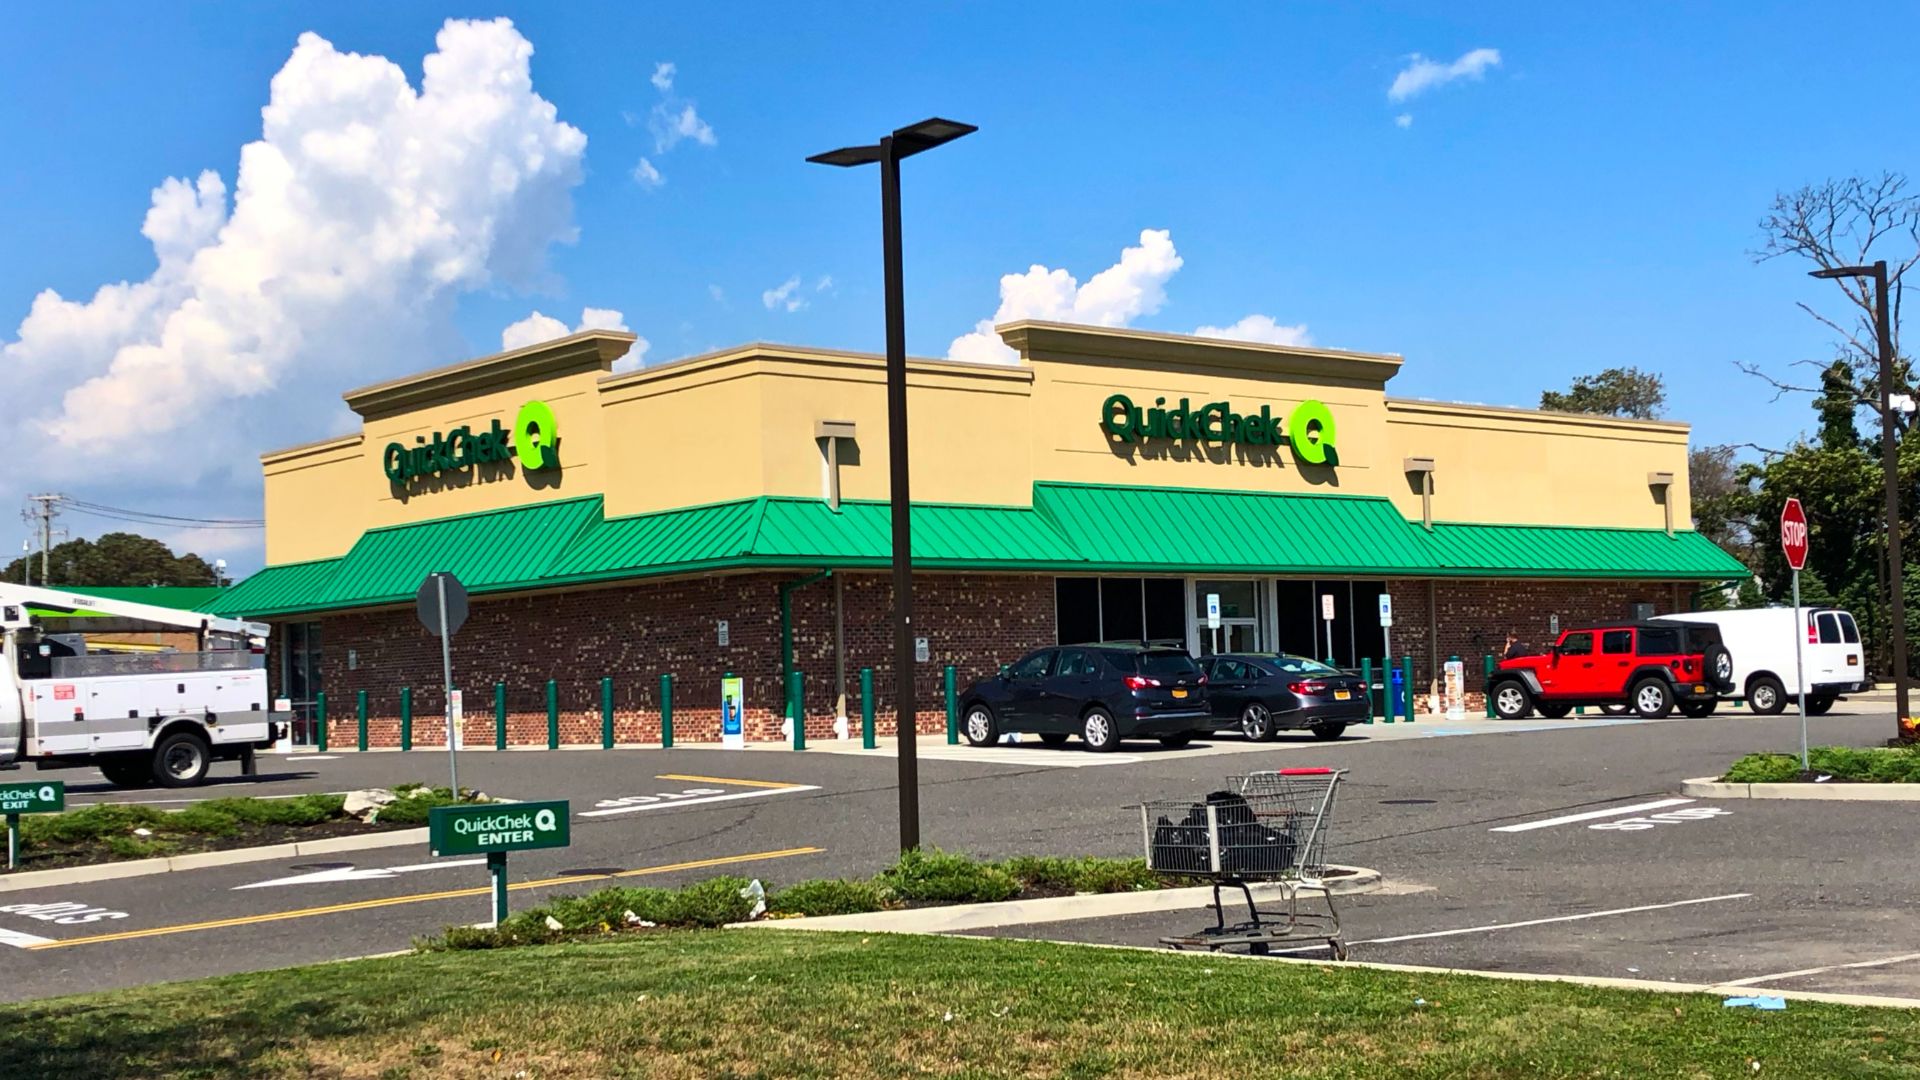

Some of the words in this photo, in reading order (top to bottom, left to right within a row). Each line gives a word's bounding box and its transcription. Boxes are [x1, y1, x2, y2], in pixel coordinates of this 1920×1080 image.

[384, 418, 512, 485] QuickChek
[515, 400, 558, 469] Q
[1102, 394, 1283, 444] QuickChek
[1289, 399, 1339, 466] Q
[1784, 520, 1806, 547] STOP
[2, 800, 29, 809] EXIT
[454, 813, 532, 835] QuickChek
[535, 809, 557, 832] Q
[477, 830, 535, 846] ENTER
